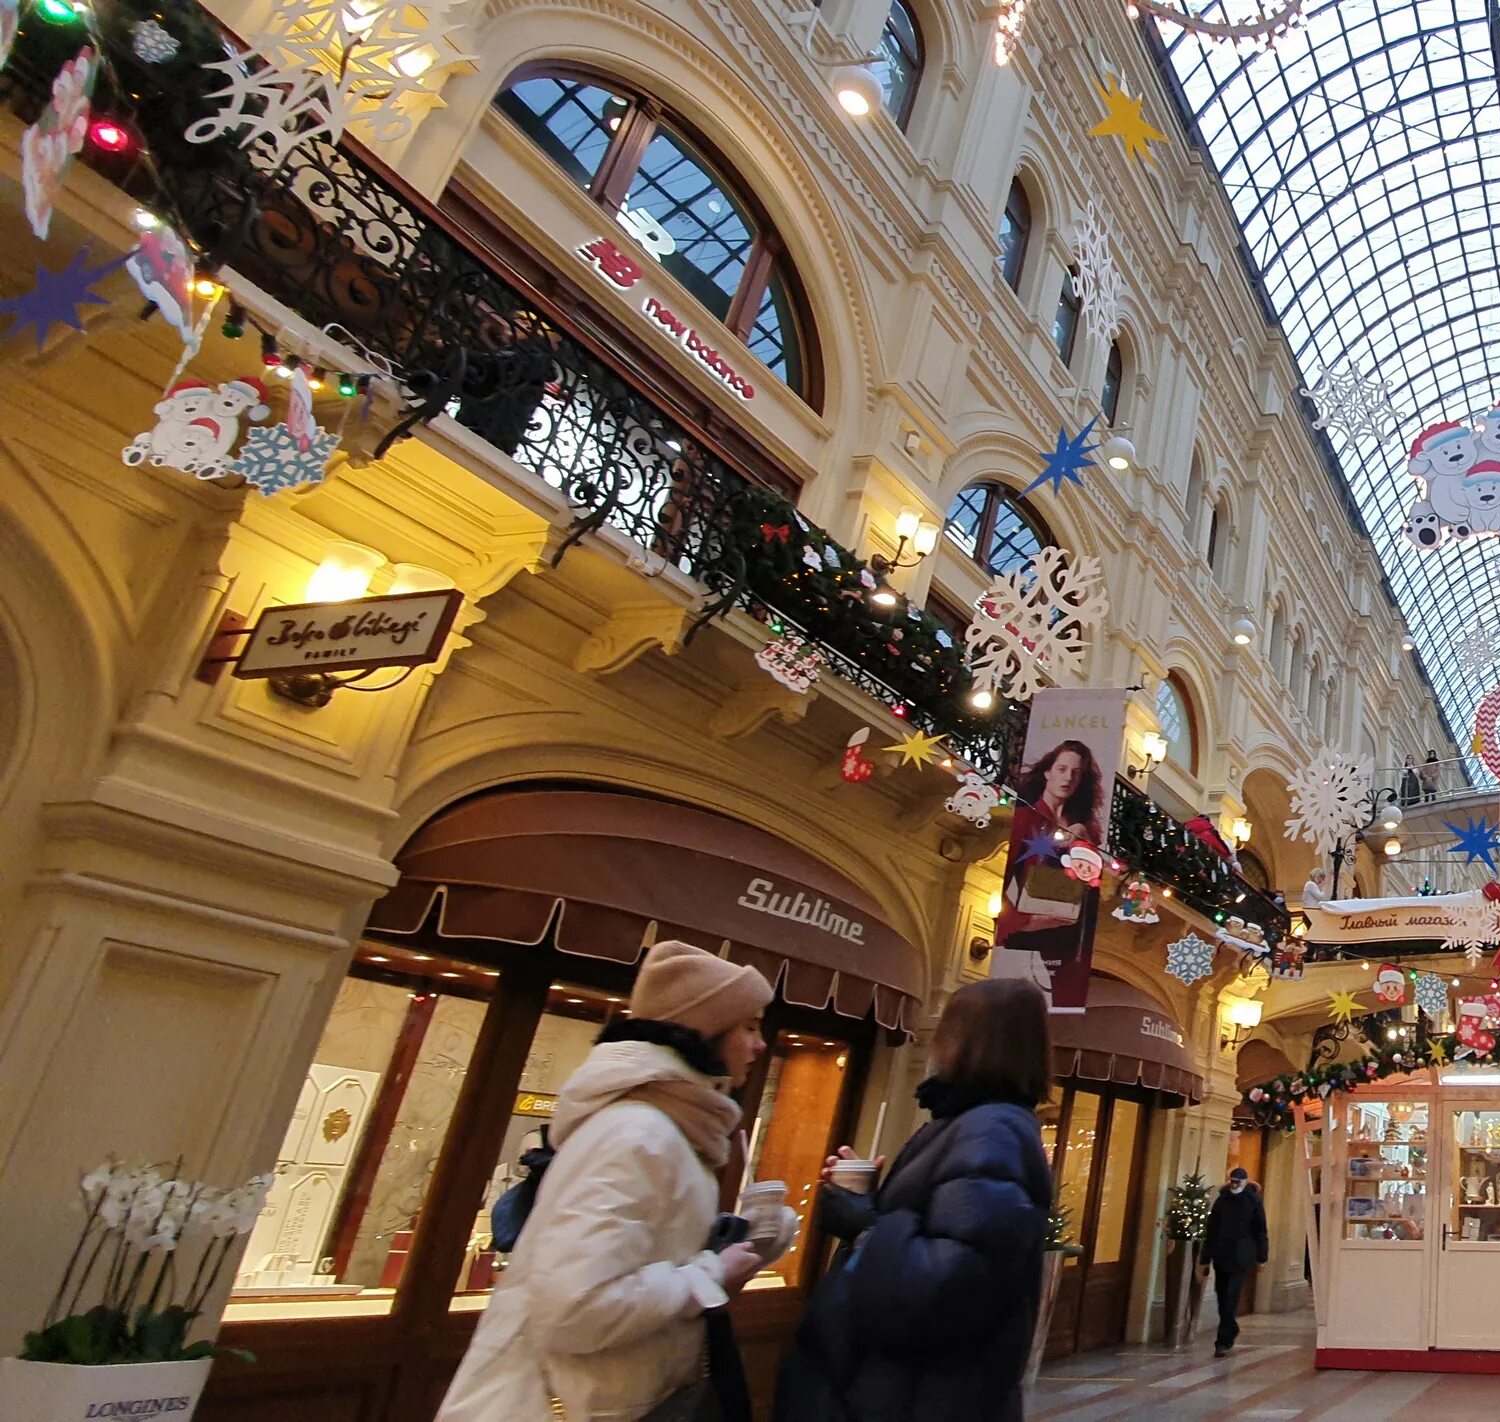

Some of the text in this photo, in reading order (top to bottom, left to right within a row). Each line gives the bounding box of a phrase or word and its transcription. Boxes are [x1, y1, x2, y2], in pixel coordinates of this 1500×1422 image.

[576, 236, 643, 290] NB
[642, 298, 755, 400] new balance
[1041, 715, 1109, 729] LANCEL
[737, 877, 865, 946] Sublime
[1339, 914, 1398, 930] Главный
[1404, 916, 1468, 927] магази
[85, 1396, 191, 1419] LONGINES
